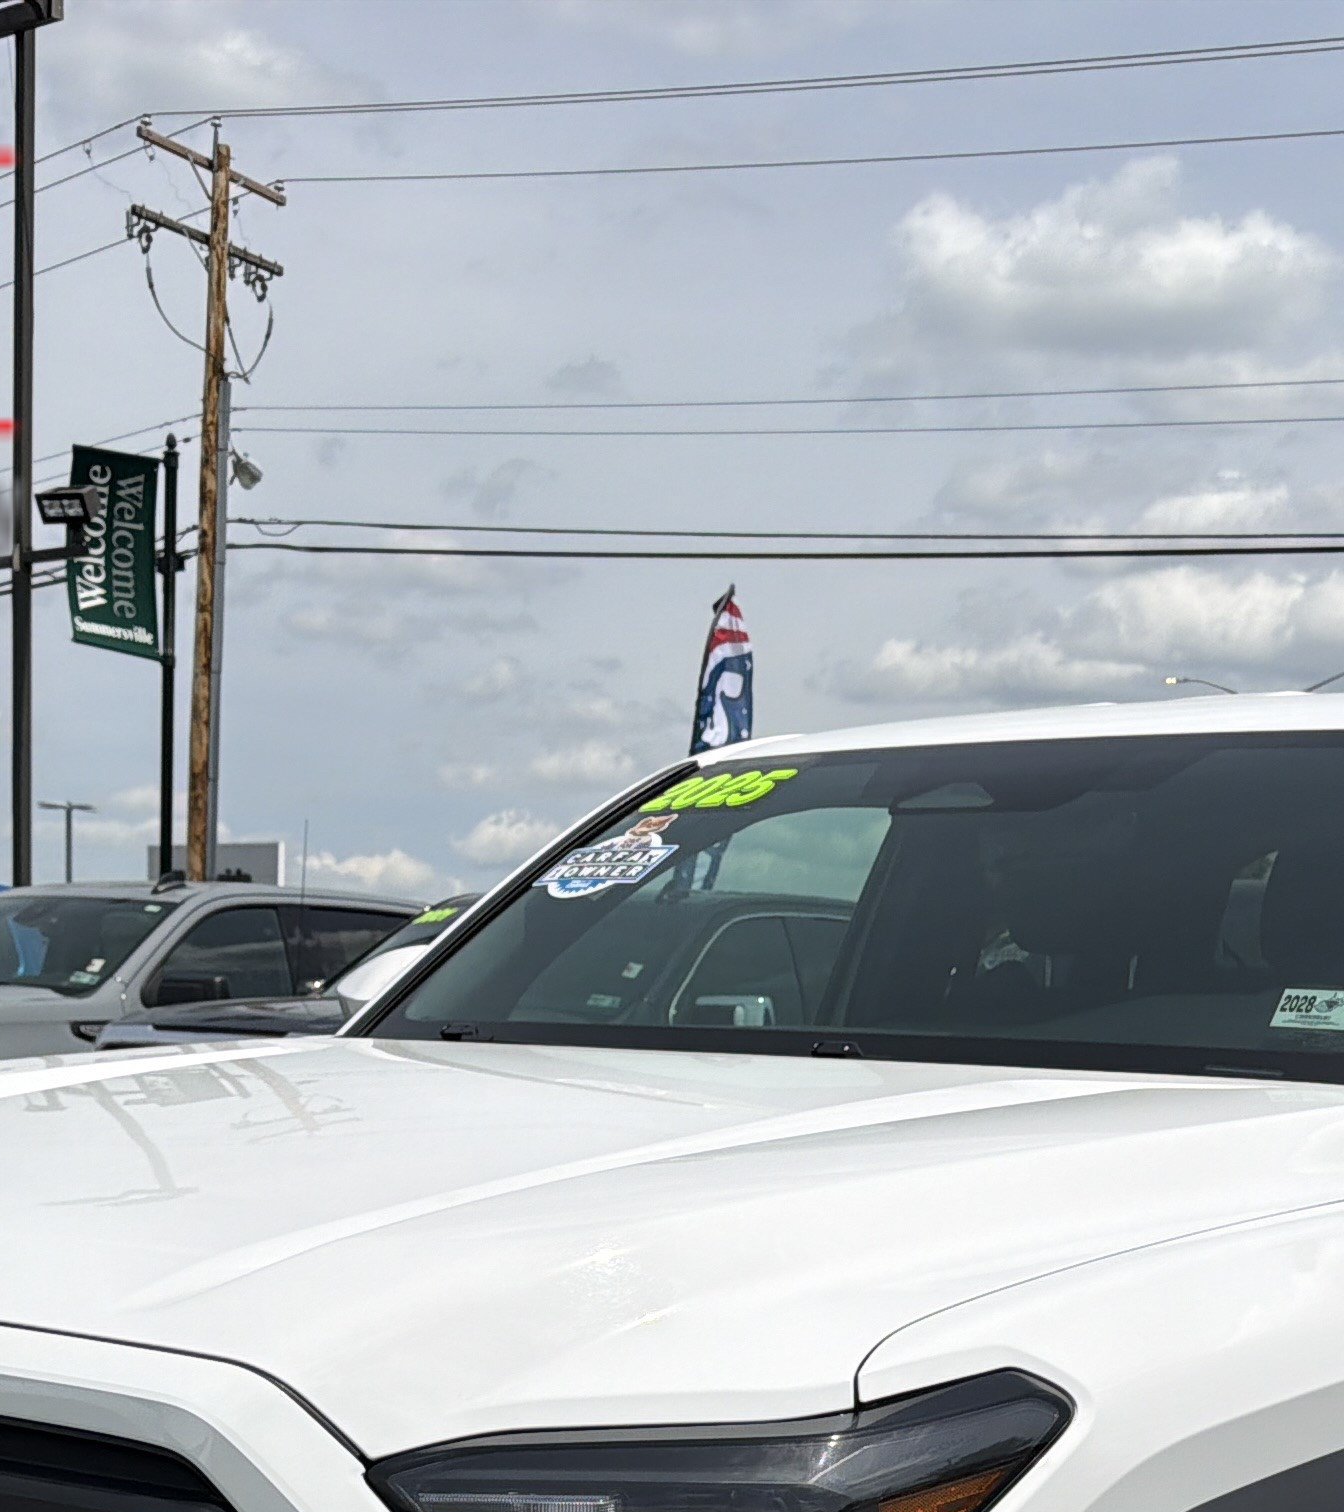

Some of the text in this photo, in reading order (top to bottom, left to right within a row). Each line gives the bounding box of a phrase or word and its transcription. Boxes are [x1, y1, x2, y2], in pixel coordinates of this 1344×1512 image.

[74, 464, 111, 611] Welcoe
[112, 474, 145, 618] Welcome
[638, 768, 799, 812] 2025
[563, 865, 644, 877] OWNER
[1279, 994, 1317, 1014] 2028
